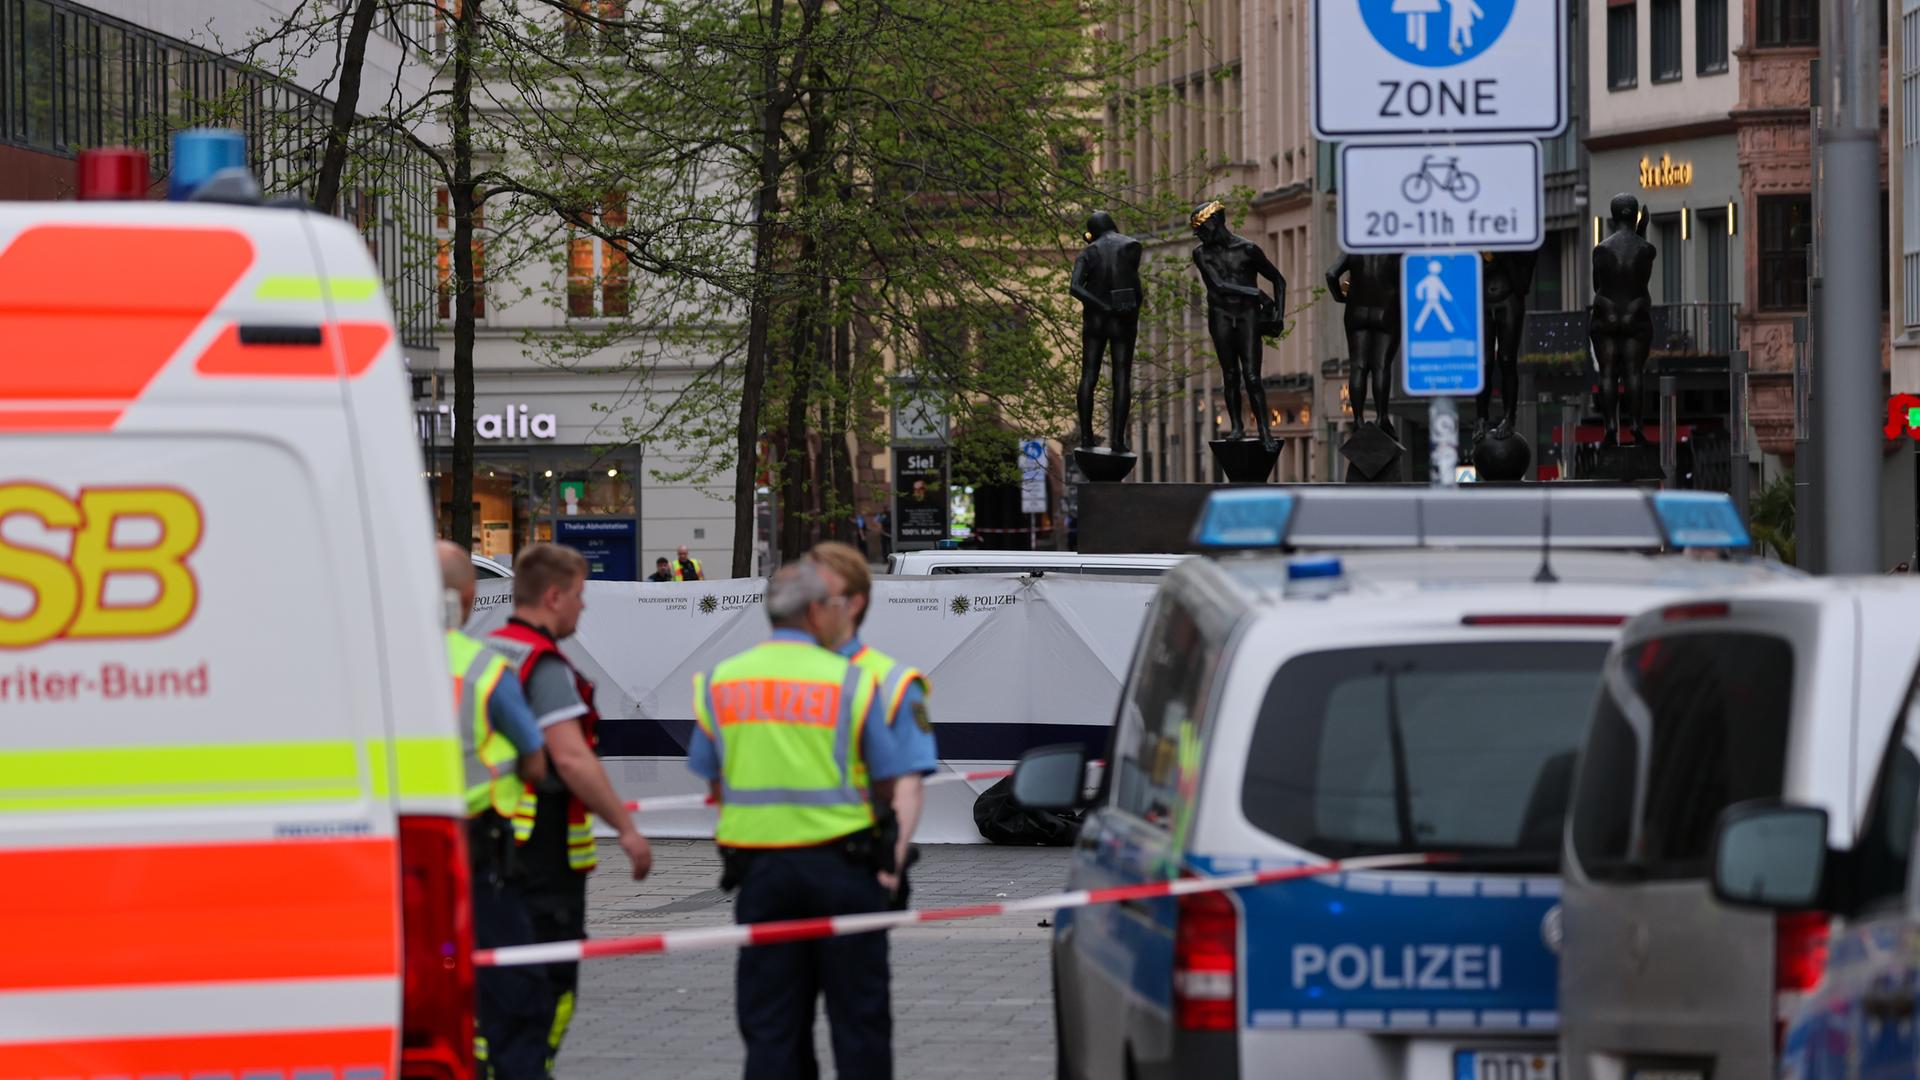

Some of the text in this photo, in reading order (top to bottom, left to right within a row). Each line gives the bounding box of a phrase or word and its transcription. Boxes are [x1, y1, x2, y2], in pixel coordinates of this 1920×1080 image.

[1379, 79, 1498, 117] ZONE
[1366, 208, 1518, 237] 20-11h frei
[430, 403, 557, 439] alia
[908, 455, 934, 469] Sie!
[0, 480, 206, 651] SB
[474, 594, 513, 606] POLIZEI
[722, 593, 763, 605] POLIZEI
[974, 594, 1016, 606] POLIZEI
[714, 682, 833, 723] POLIZEI
[1292, 944, 1501, 989] POLIZEI
